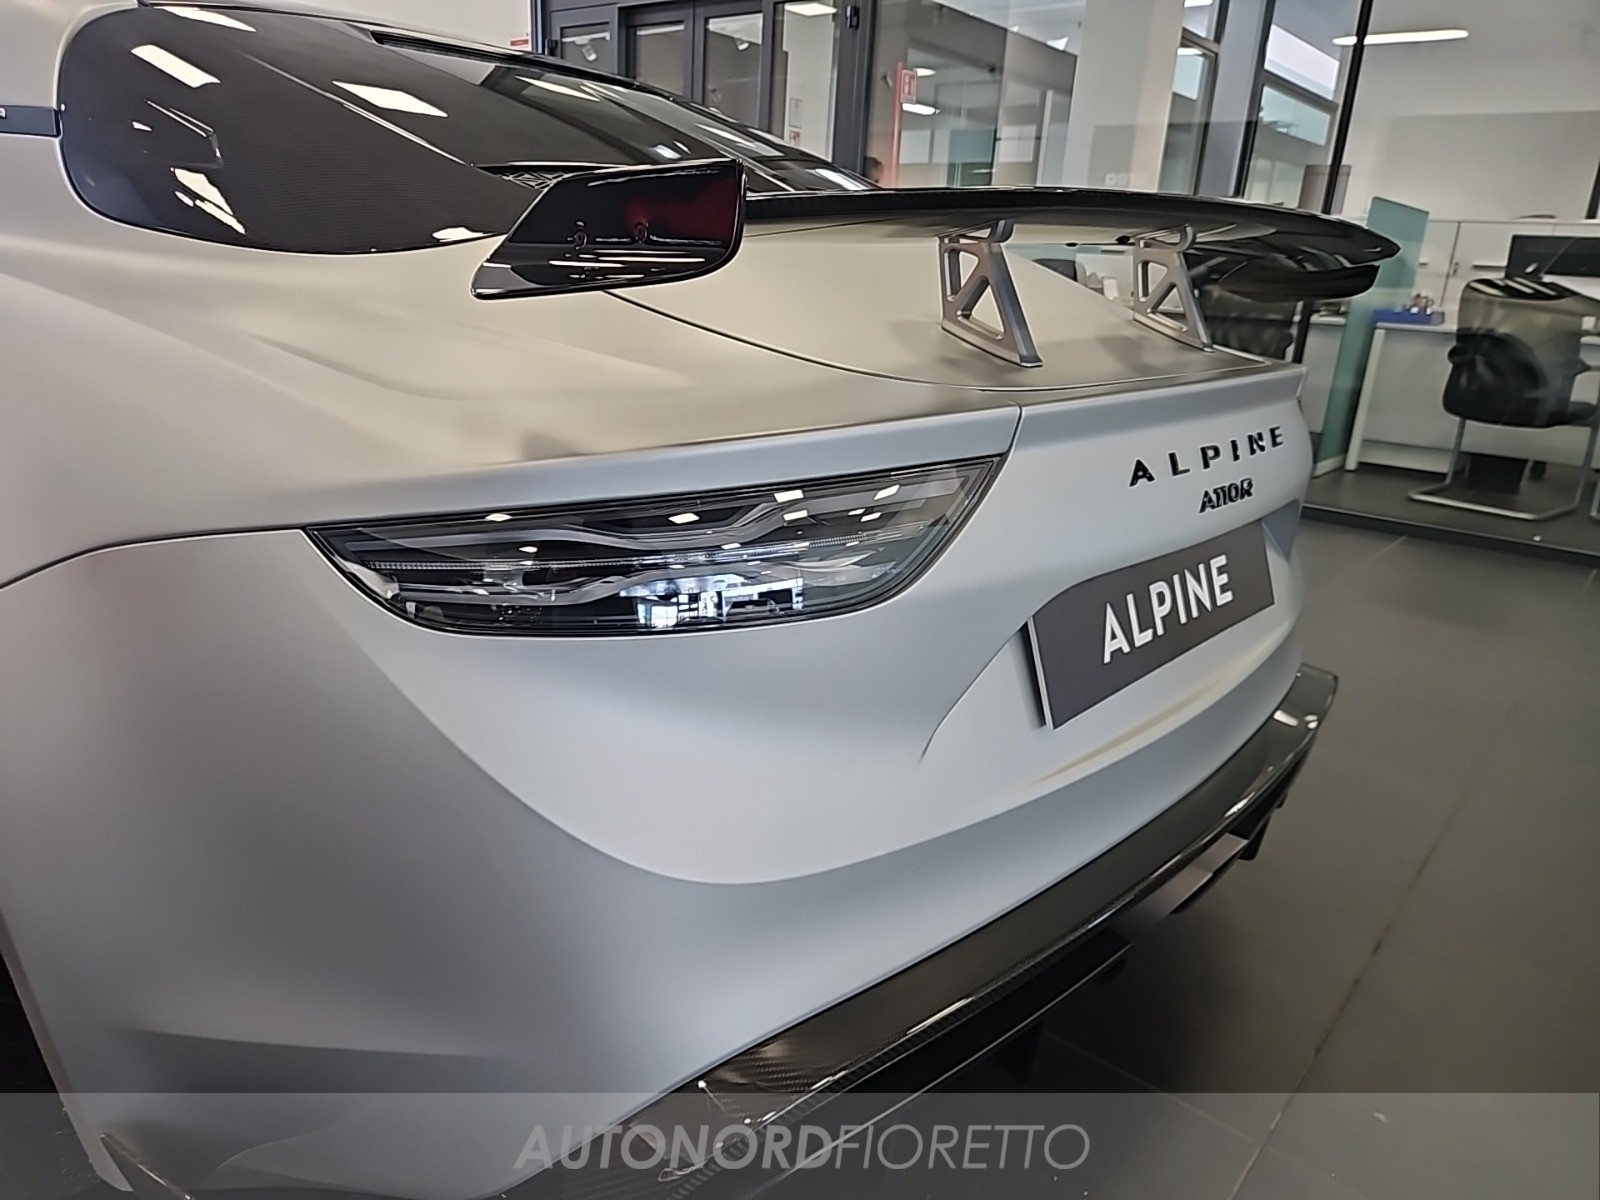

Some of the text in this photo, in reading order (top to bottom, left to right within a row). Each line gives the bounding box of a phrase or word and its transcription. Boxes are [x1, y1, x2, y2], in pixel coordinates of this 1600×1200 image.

[1129, 426, 1283, 487] ALPINE
[1199, 478, 1253, 513] A110R
[1103, 554, 1233, 664] ALPINE
